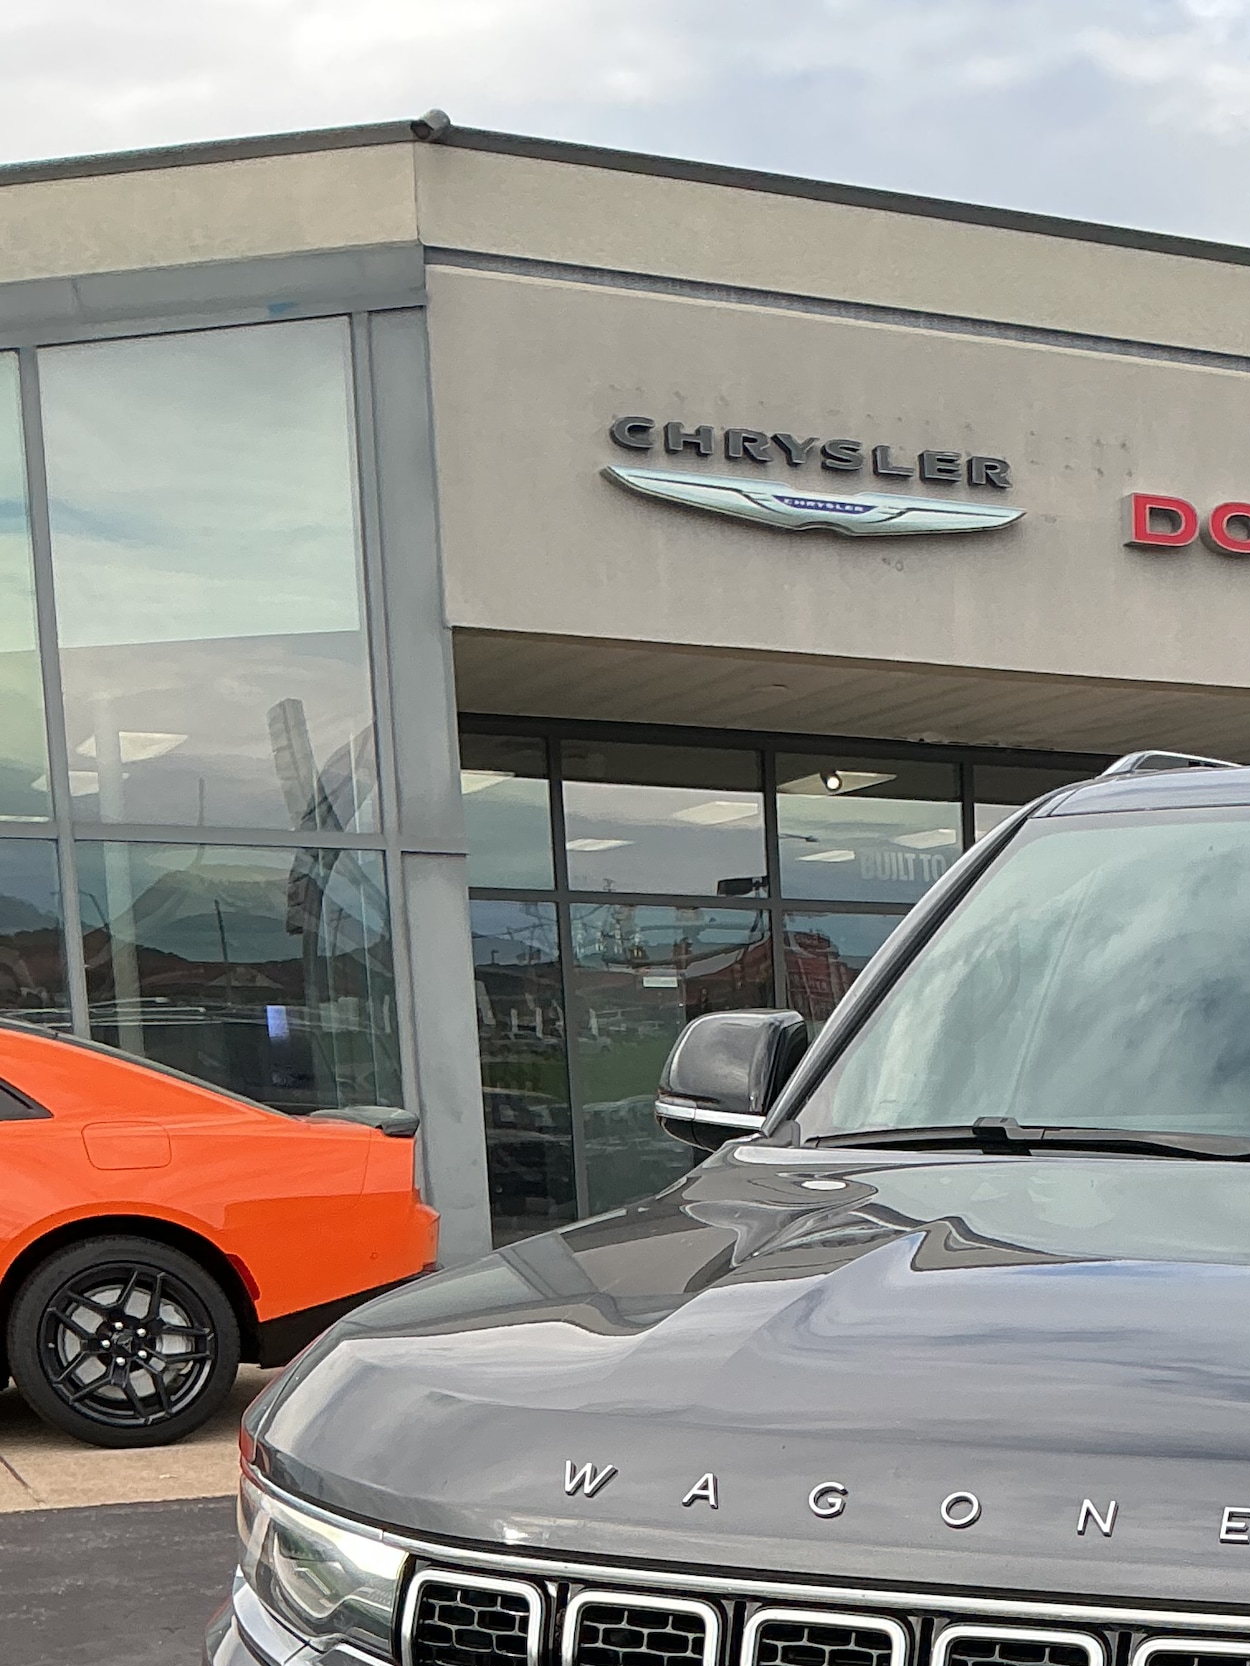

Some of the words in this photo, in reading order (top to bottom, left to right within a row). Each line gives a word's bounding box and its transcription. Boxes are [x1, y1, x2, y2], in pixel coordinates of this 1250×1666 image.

[609, 416, 1013, 488] CHRYSLER
[783, 498, 864, 512] CHRYSLER
[861, 852, 915, 881] BUILT
[919, 853, 946, 881] TO
